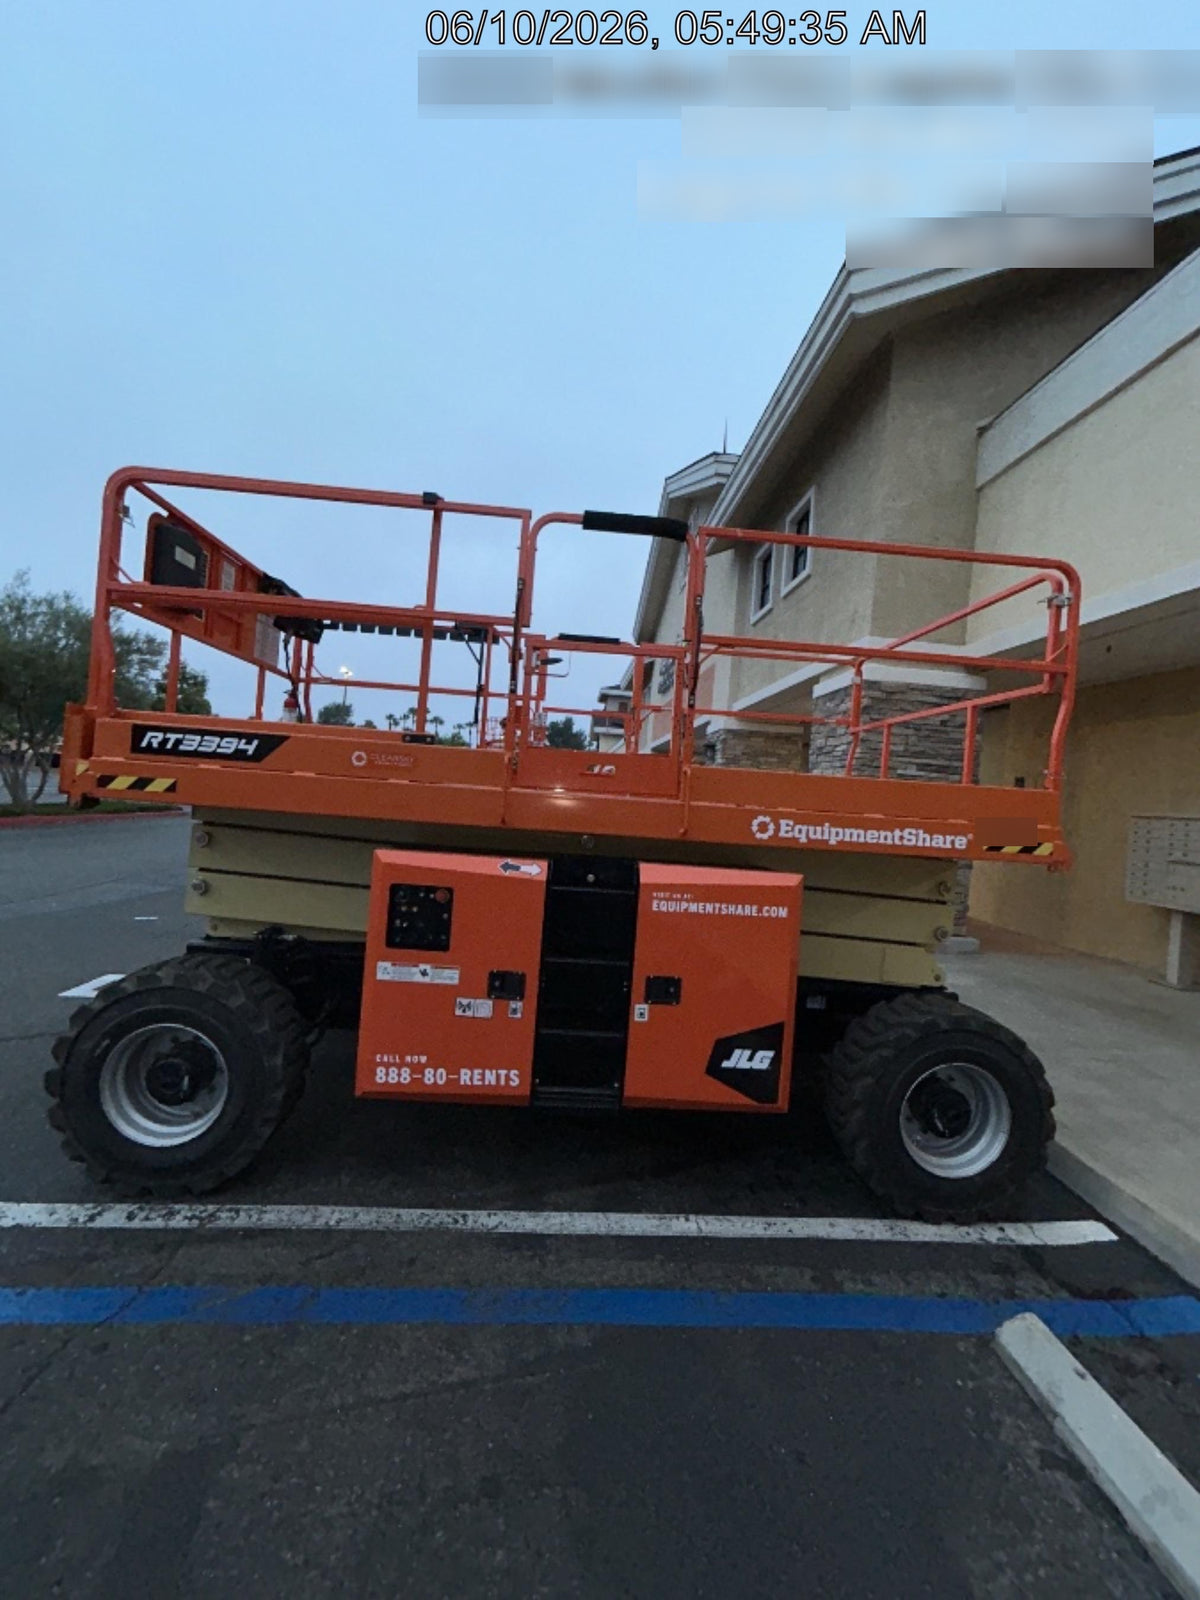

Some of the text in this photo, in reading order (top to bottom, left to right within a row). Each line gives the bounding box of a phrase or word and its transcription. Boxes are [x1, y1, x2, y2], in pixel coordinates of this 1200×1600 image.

[139, 731, 260, 756] RT3394
[652, 899, 789, 918] EQUIPMENTSHARE.COM
[375, 1053, 428, 1064] CALL NOW
[721, 1048, 776, 1070] JLG
[375, 1066, 520, 1087] 888-80-RENTS
